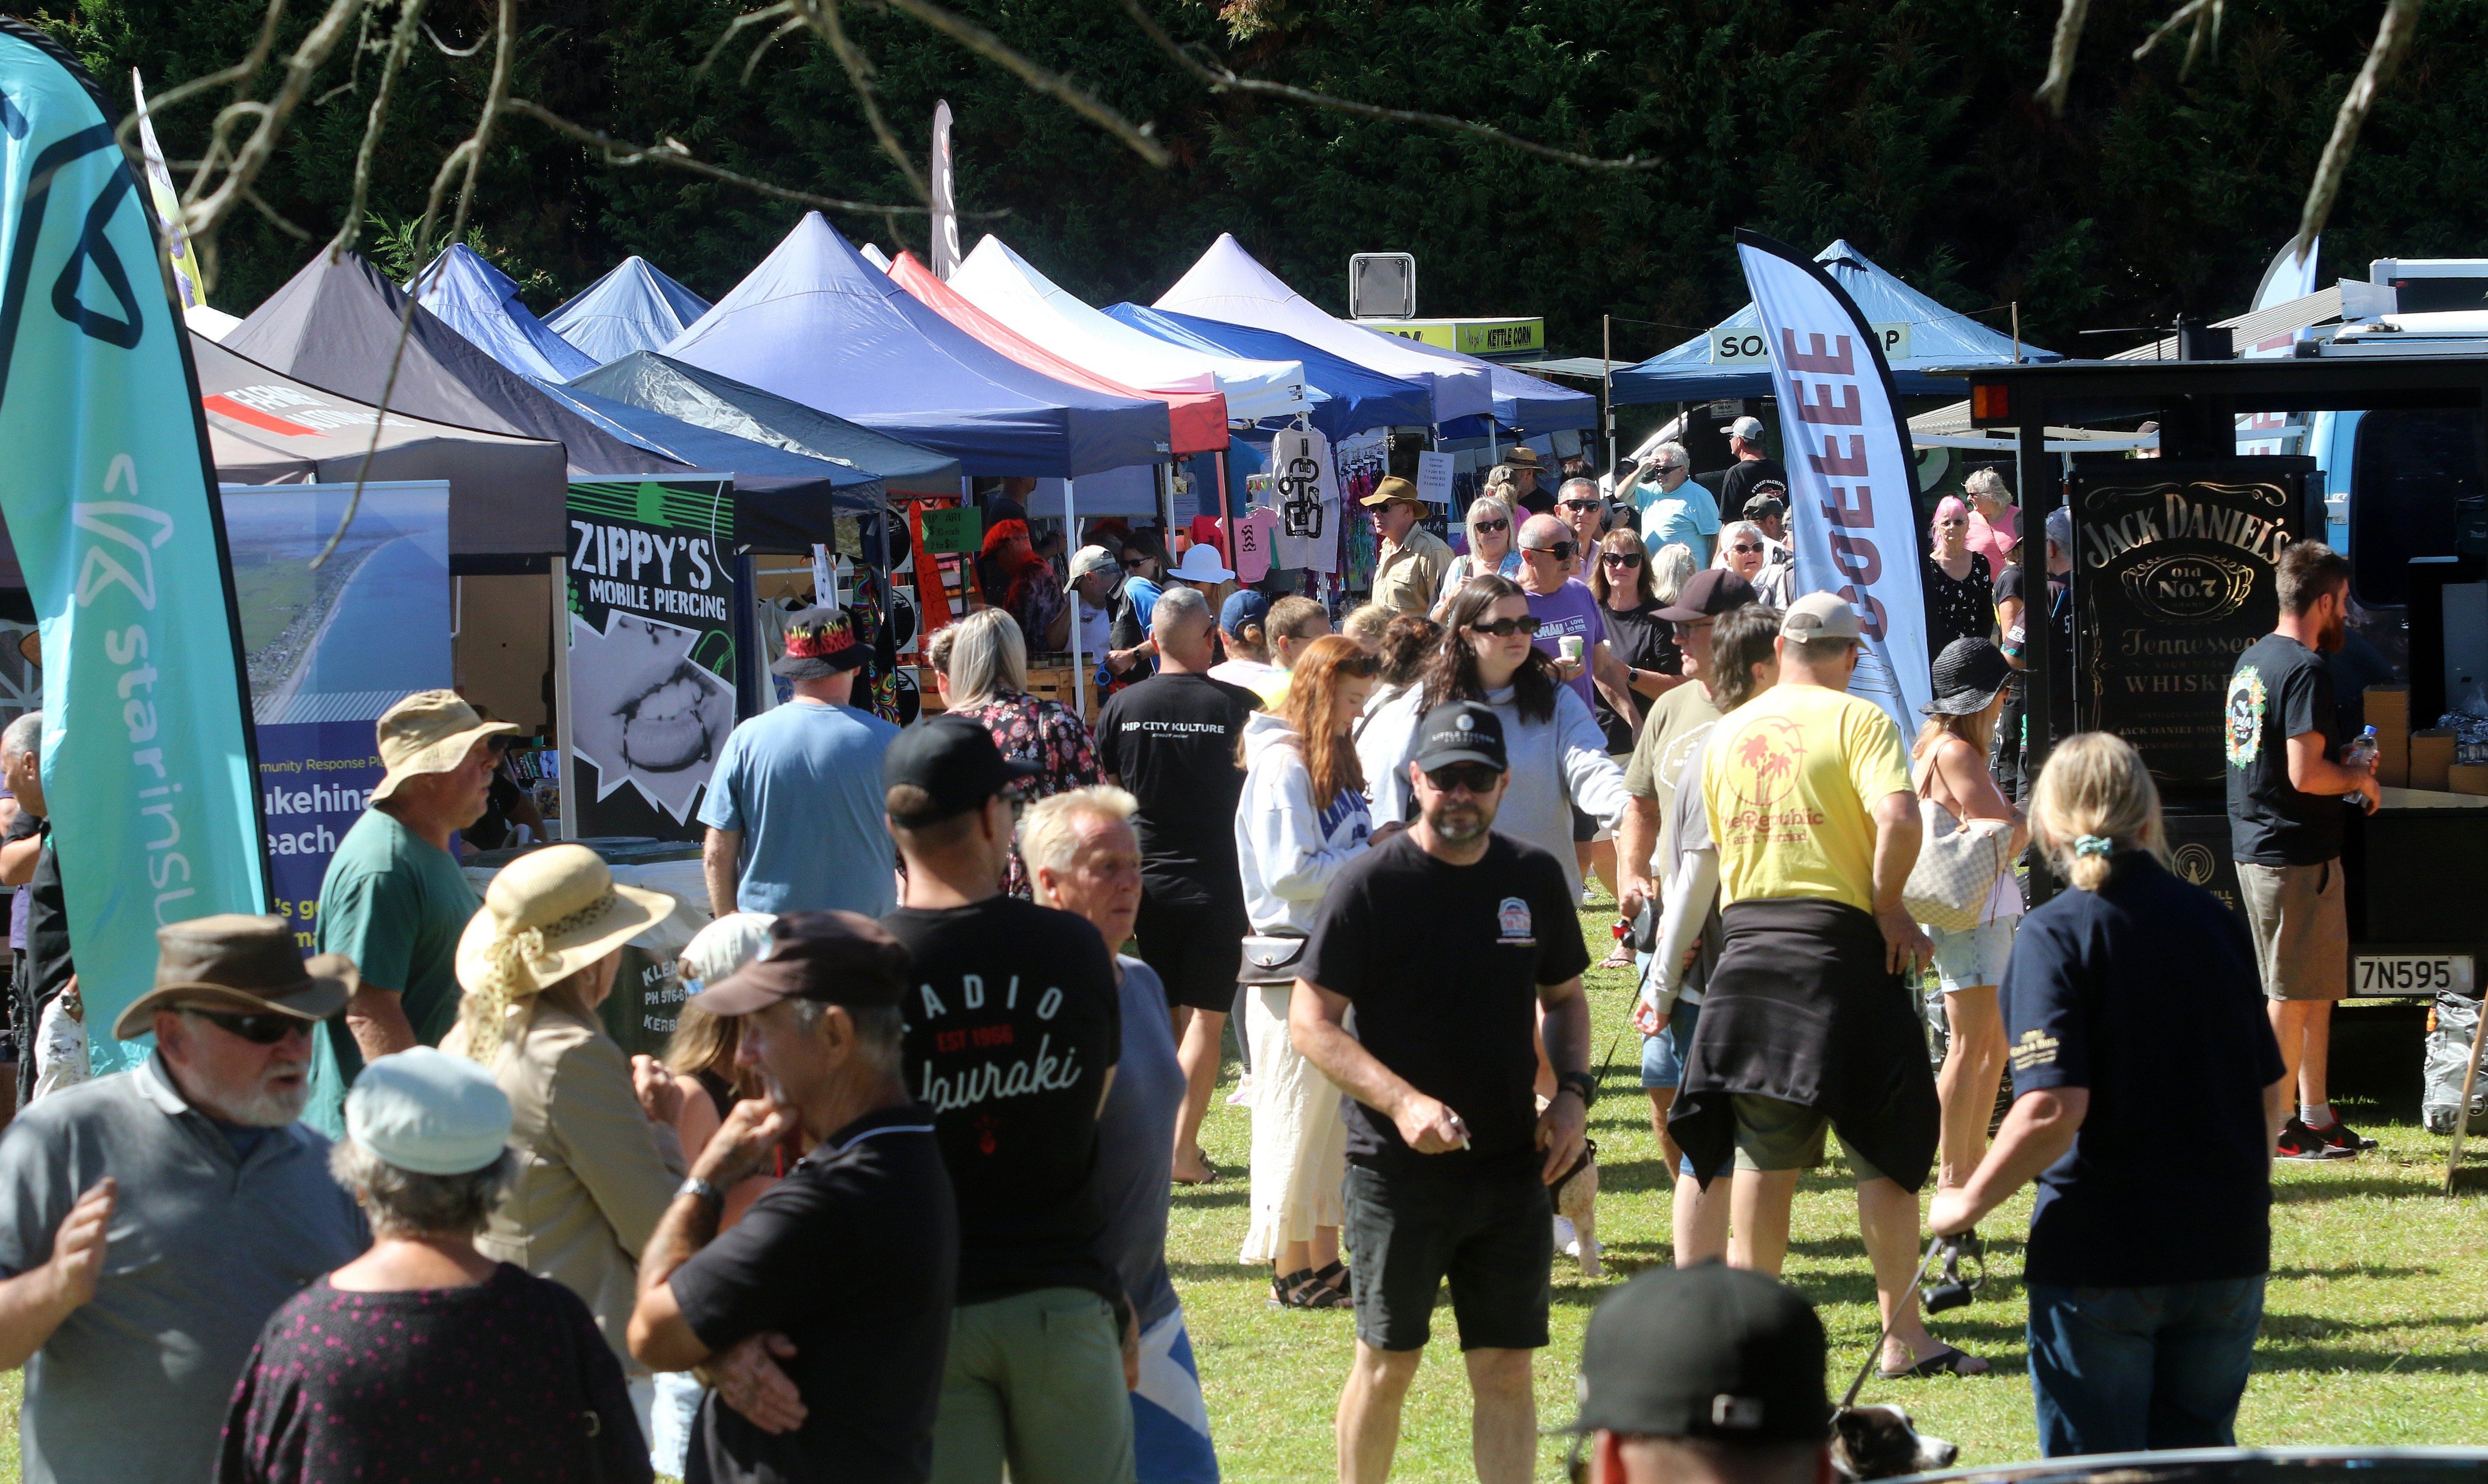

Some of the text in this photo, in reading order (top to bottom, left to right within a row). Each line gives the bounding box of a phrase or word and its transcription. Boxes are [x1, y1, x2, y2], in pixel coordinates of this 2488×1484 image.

[1487, 328, 1512, 349] KETTLE
[1513, 326, 1531, 346] CORN
[1782, 327, 1888, 642] COFFEE
[2083, 493, 2292, 569] JACK DANIEL'S
[571, 520, 712, 590] ZIPPY'S
[2171, 567, 2201, 578] Old
[589, 578, 726, 621] MOBILE PIERCING
[2158, 579, 2217, 599] No.7
[1121, 721, 1225, 734] HIP CITY KULTURE
[306, 758, 366, 772] Response
[2360, 961, 2451, 989] 7N595
[644, 990, 659, 1005] PH
[902, 974, 1064, 1034] ADIO
